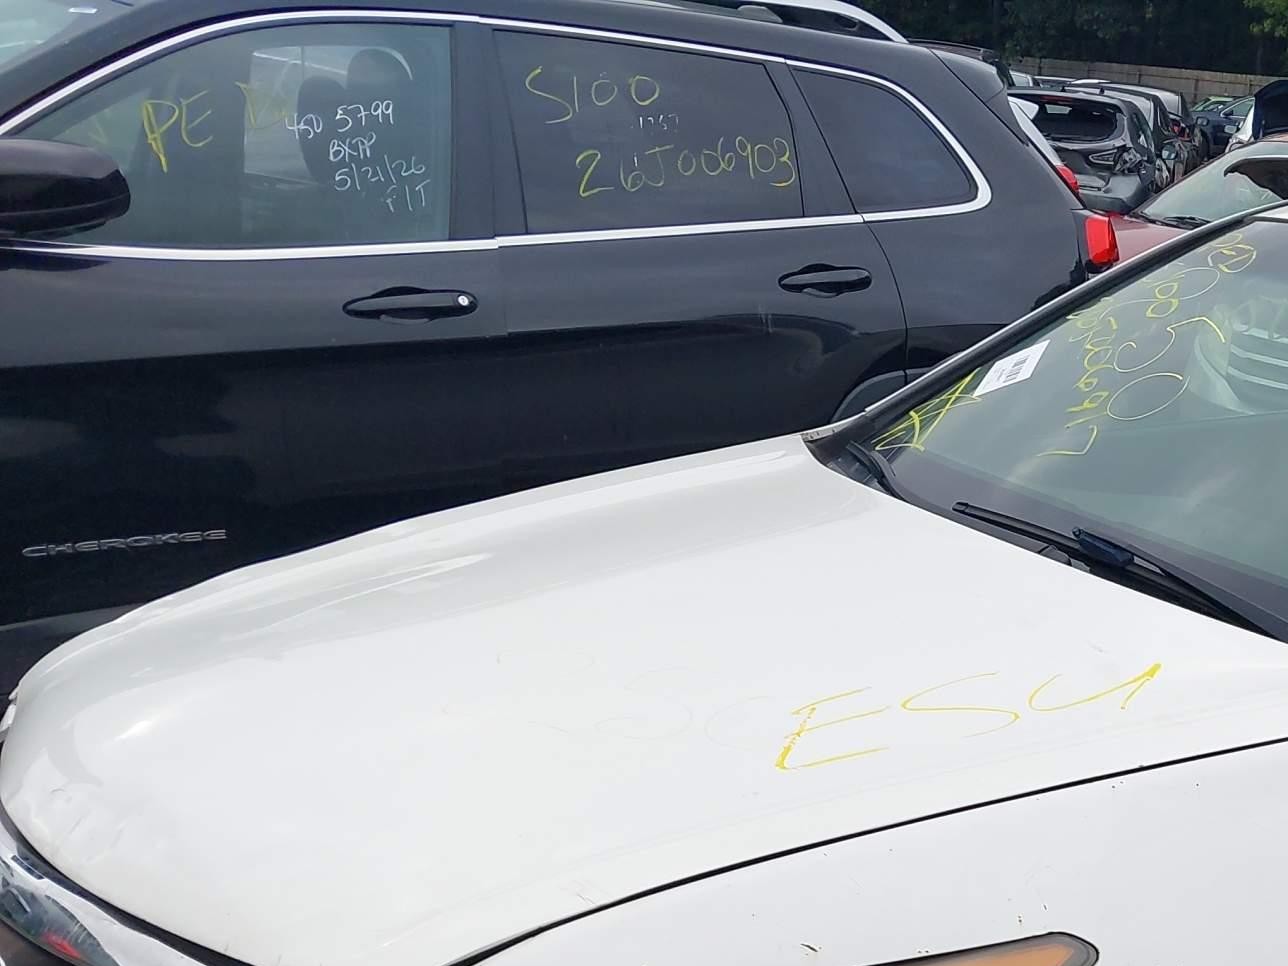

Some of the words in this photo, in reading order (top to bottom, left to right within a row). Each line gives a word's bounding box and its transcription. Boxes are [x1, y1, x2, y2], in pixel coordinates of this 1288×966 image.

[525, 66, 660, 124] S100
[335, 100, 394, 133] 5799
[21, 529, 228, 557] CHEROKEE
